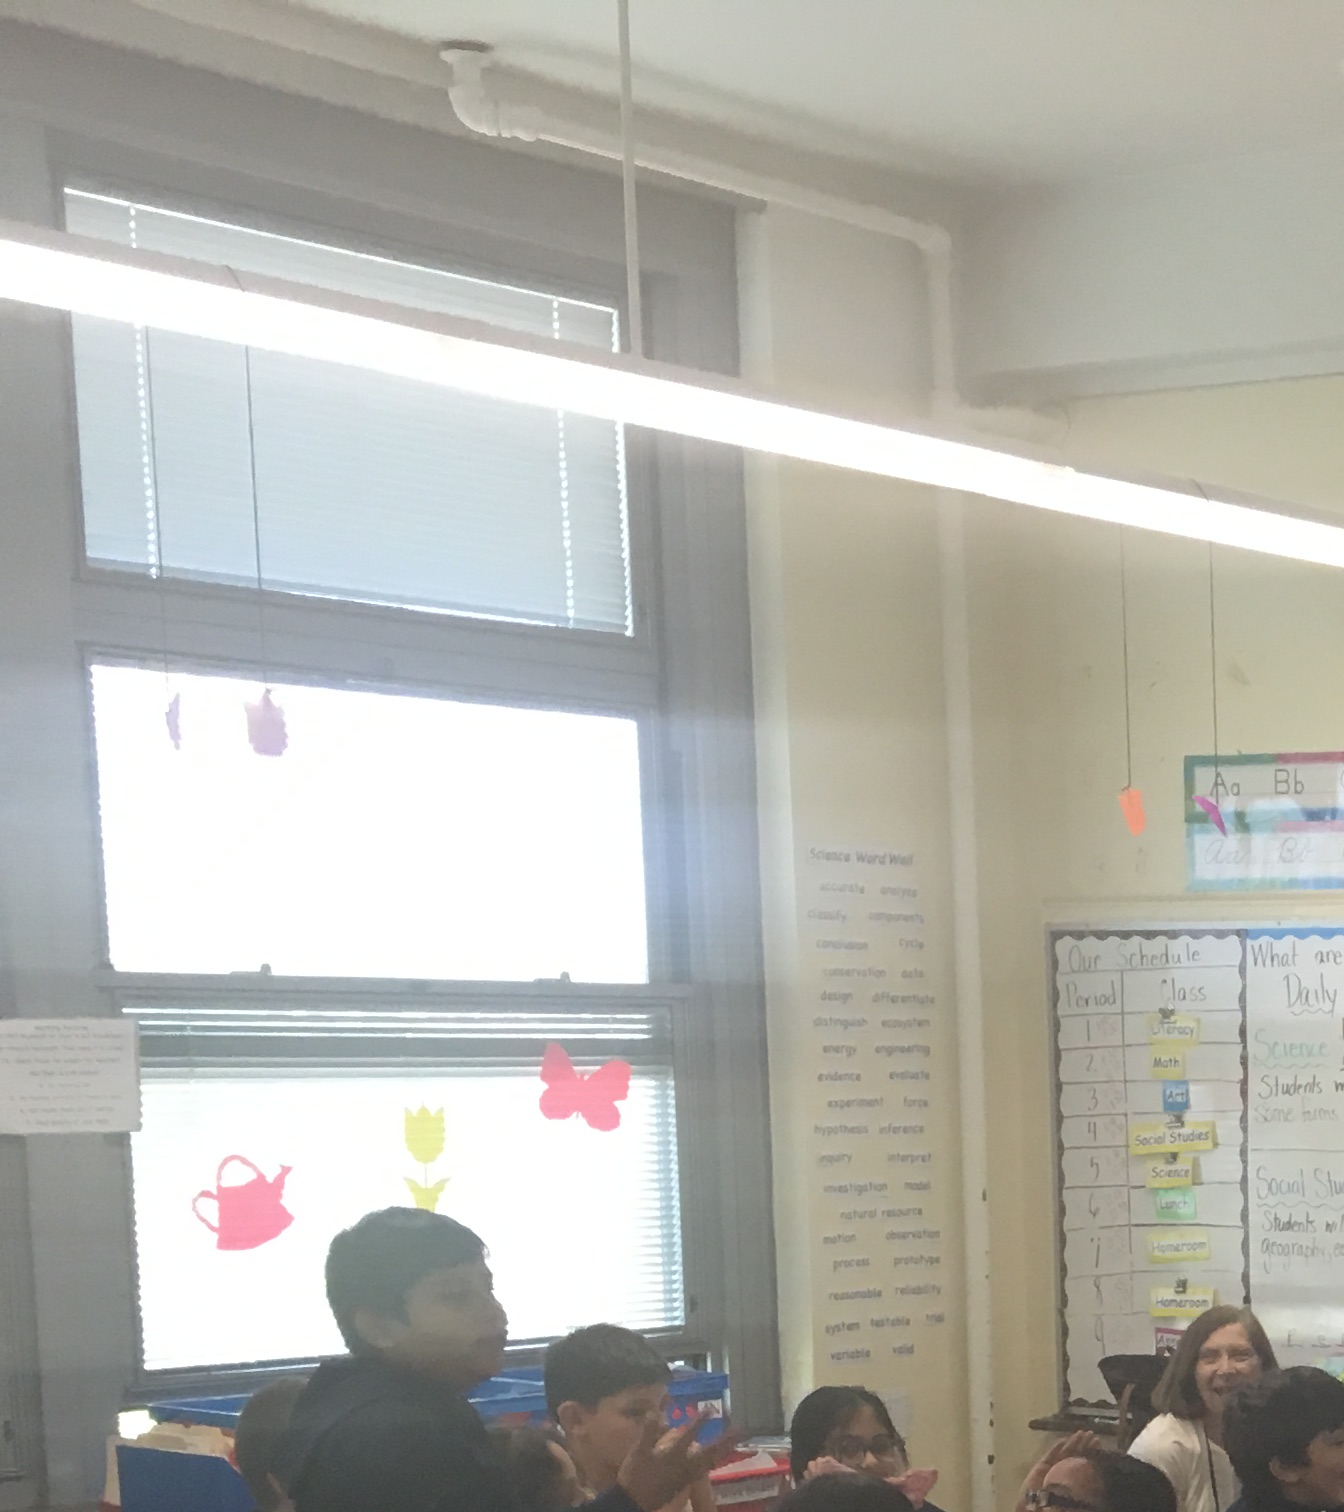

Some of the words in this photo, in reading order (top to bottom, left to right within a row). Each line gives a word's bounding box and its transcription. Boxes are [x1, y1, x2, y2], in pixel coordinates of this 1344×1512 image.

[1210, 772, 1240, 797] Aa
[1275, 769, 1305, 795] Bb
[810, 848, 850, 863] Science
[855, 850, 887, 865] Word
[889, 853, 914, 866] Wall
[1069, 944, 1101, 972] Our
[1116, 942, 1201, 968] Schedule
[1251, 941, 1299, 968] What
[1315, 949, 1343, 966] are
[820, 990, 853, 1004] design
[1066, 980, 1116, 1008] Period
[1160, 977, 1207, 1002] Class
[1283, 971, 1337, 1016] Daily
[1085, 1019, 1091, 1042] 1
[1151, 1021, 1195, 1039] Literacy
[822, 1043, 857, 1057] energy
[1153, 1056, 1180, 1068] Math
[817, 1071, 861, 1083] evidence
[1167, 1087, 1186, 1101] Art
[1258, 1073, 1323, 1099] Students
[1087, 1087, 1098, 1111] 3
[1087, 1121, 1097, 1142] 4
[1135, 1133, 1166, 1146] Social
[1170, 1130, 1210, 1143] Studies
[1090, 1157, 1100, 1180] 5
[1151, 1166, 1191, 1179] Science
[1256, 1164, 1305, 1200] Social
[1159, 1197, 1190, 1210] Lunch
[840, 1207, 877, 1219] natural
[1262, 1211, 1318, 1233] Students
[822, 1232, 857, 1244] motion
[1152, 1240, 1207, 1253] Homeroom
[833, 1256, 870, 1271] process
[893, 1254, 941, 1268] prototype
[1155, 1297, 1210, 1309] Homeroom
[825, 1321, 861, 1335] system
